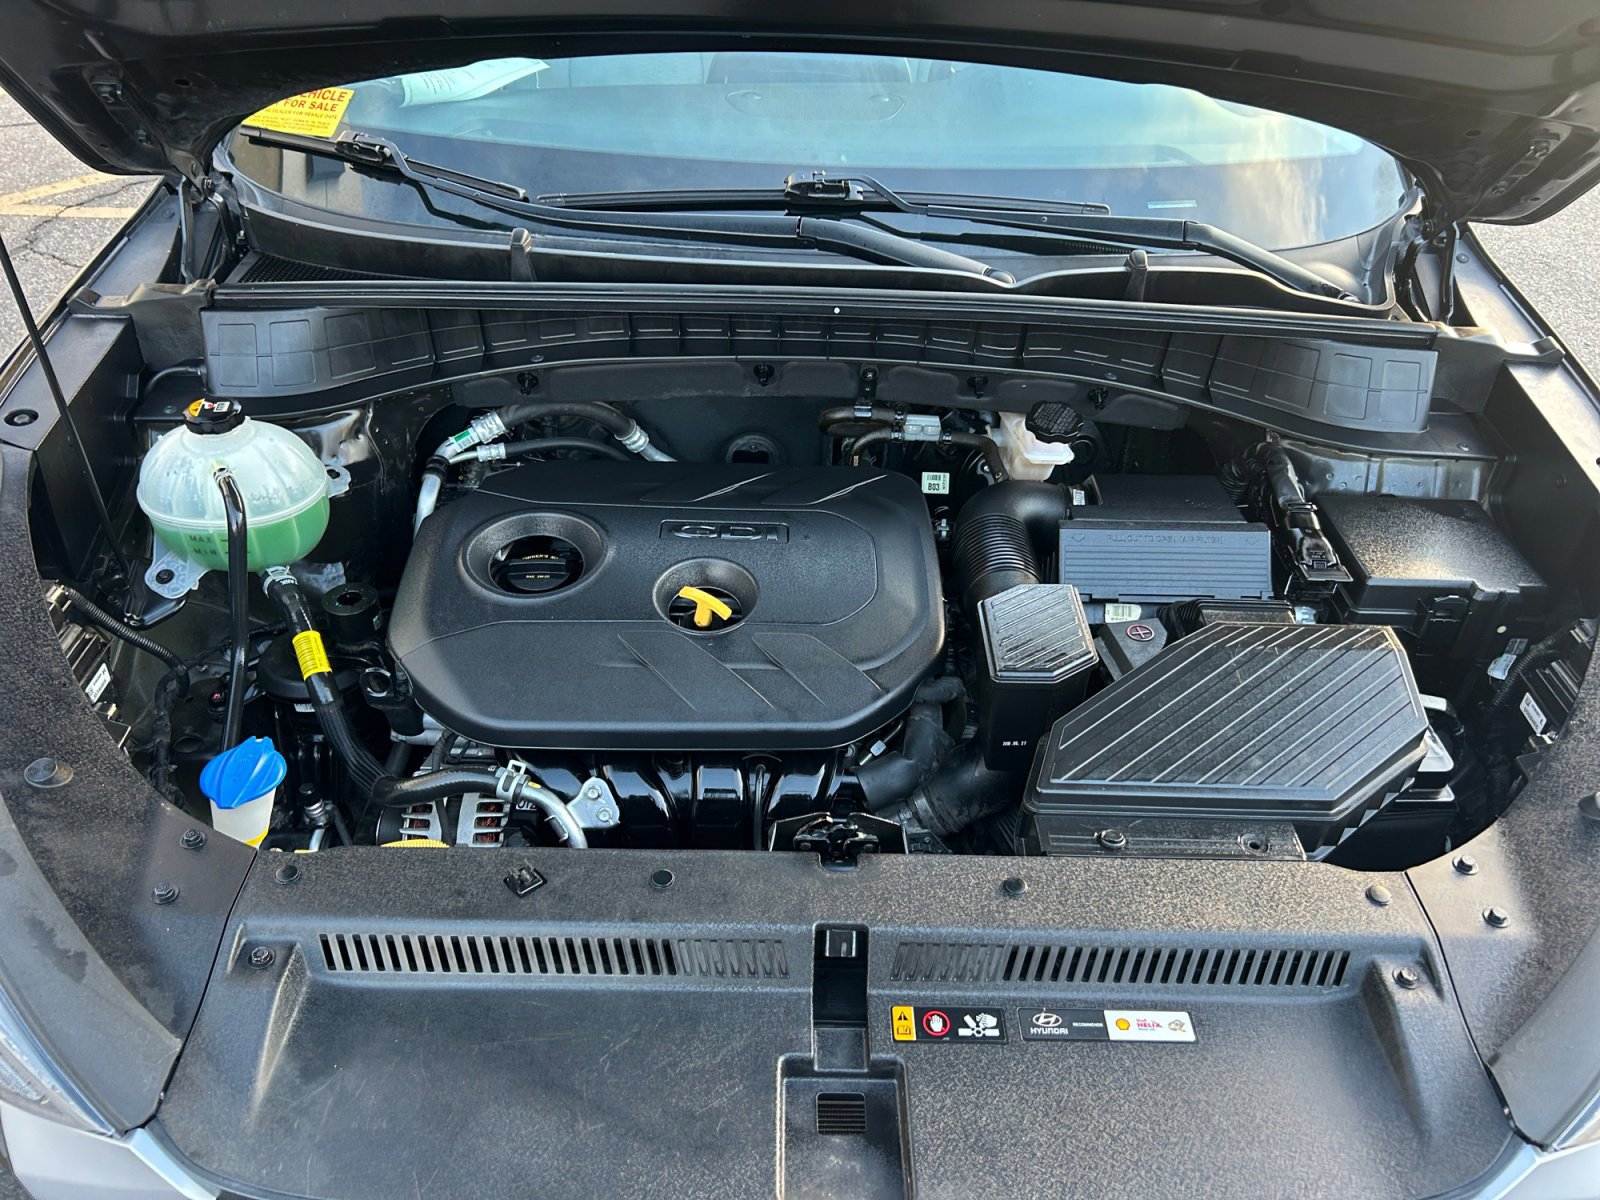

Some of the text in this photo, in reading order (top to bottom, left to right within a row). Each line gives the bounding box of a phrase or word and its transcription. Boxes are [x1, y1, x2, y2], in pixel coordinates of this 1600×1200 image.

[284, 98, 338, 112] FOR SALE
[1030, 1027, 1069, 1035] HYUNDAI
